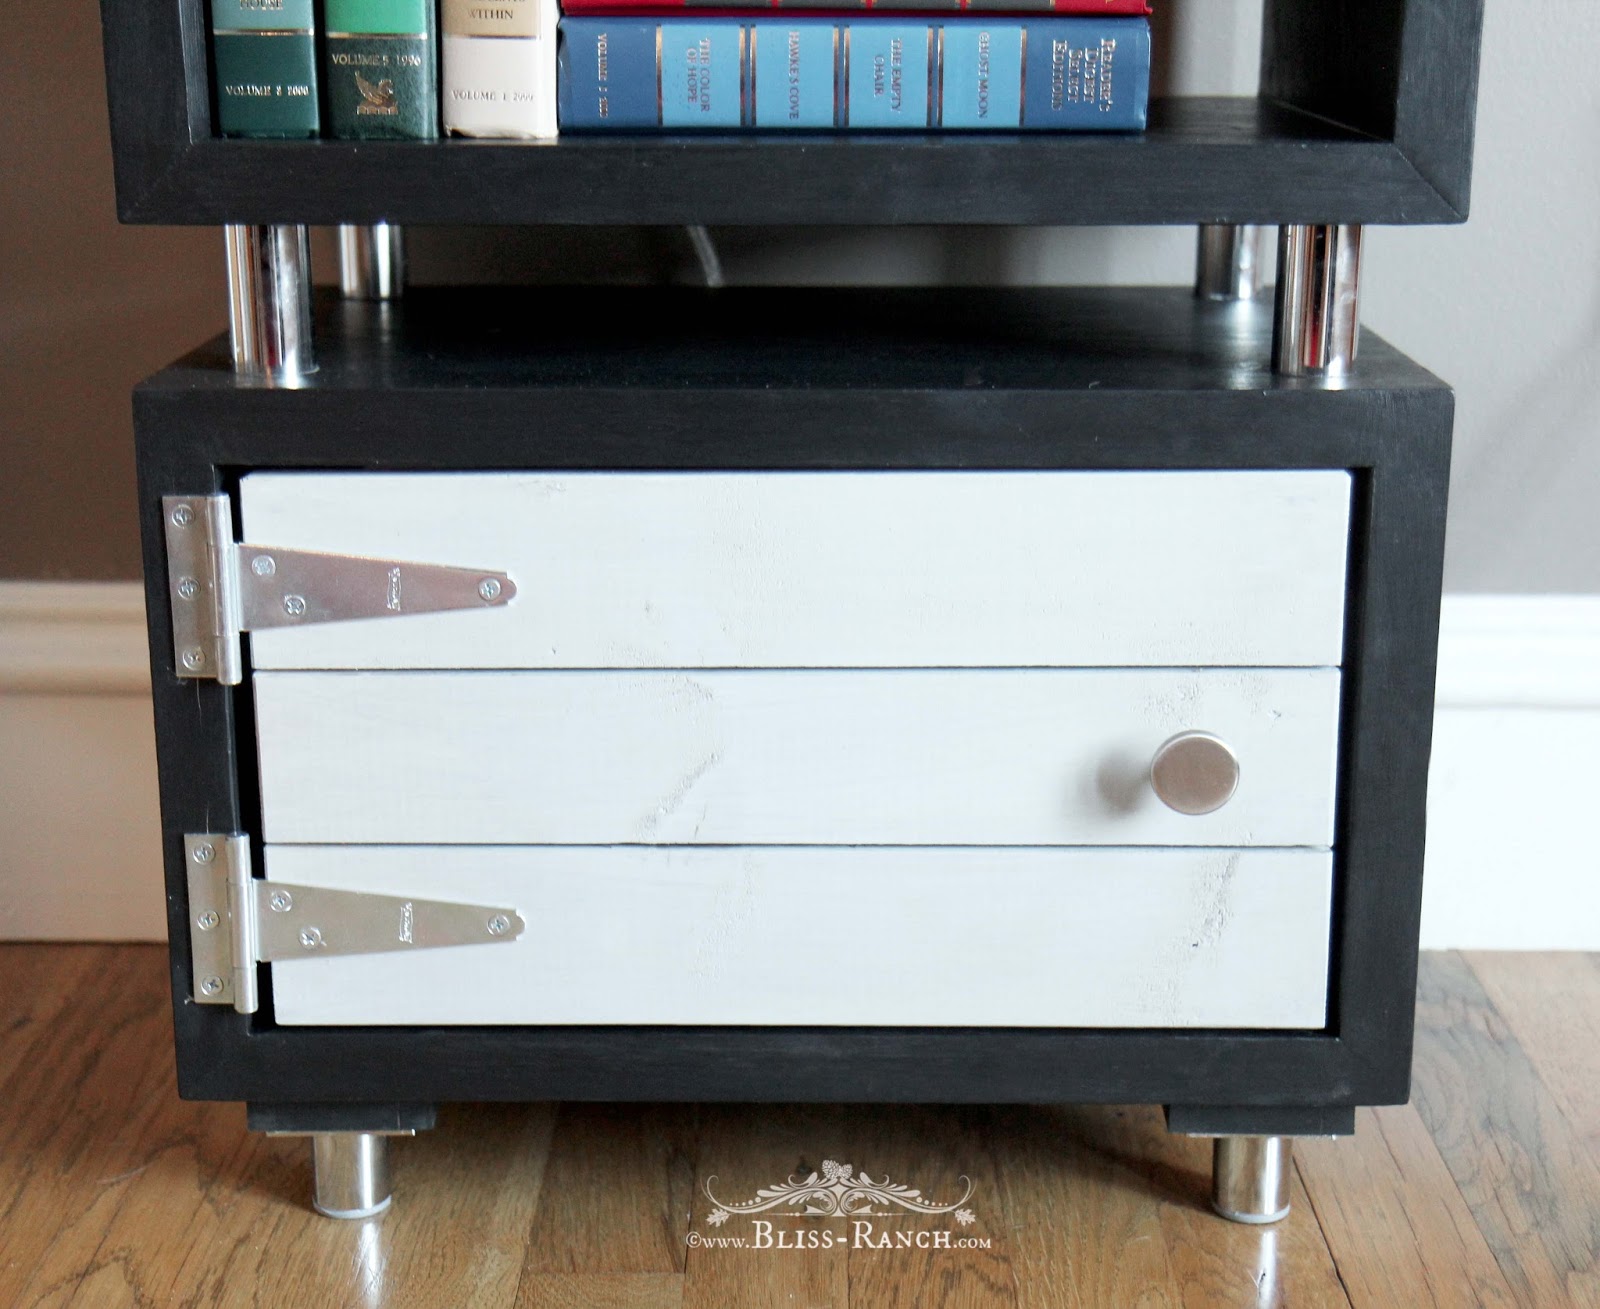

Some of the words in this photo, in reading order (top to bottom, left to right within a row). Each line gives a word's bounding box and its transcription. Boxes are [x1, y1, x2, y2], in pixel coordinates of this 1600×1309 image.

[468, 9, 514, 20] WITHIN
[332, 54, 379, 66] VOLUME
[598, 33, 607, 81] VOLUME
[687, 47, 698, 63] OF
[700, 38, 711, 65] THE
[890, 38, 902, 66] THE
[978, 32, 990, 77] GHOST
[225, 85, 271, 96] VOLUME
[687, 68, 697, 103] HOPE
[700, 68, 710, 112] COLOR
[873, 55, 885, 98] CHAIR
[890, 68, 902, 113] EMPTY
[1051, 40, 1068, 112] EDITIONS
[1067, 49, 1083, 103] SELECT
[1083, 47, 1099, 104] DIGEST
[452, 90, 495, 101] VOLUME
[788, 87, 800, 120] COVE
[978, 79, 988, 118] MOON
